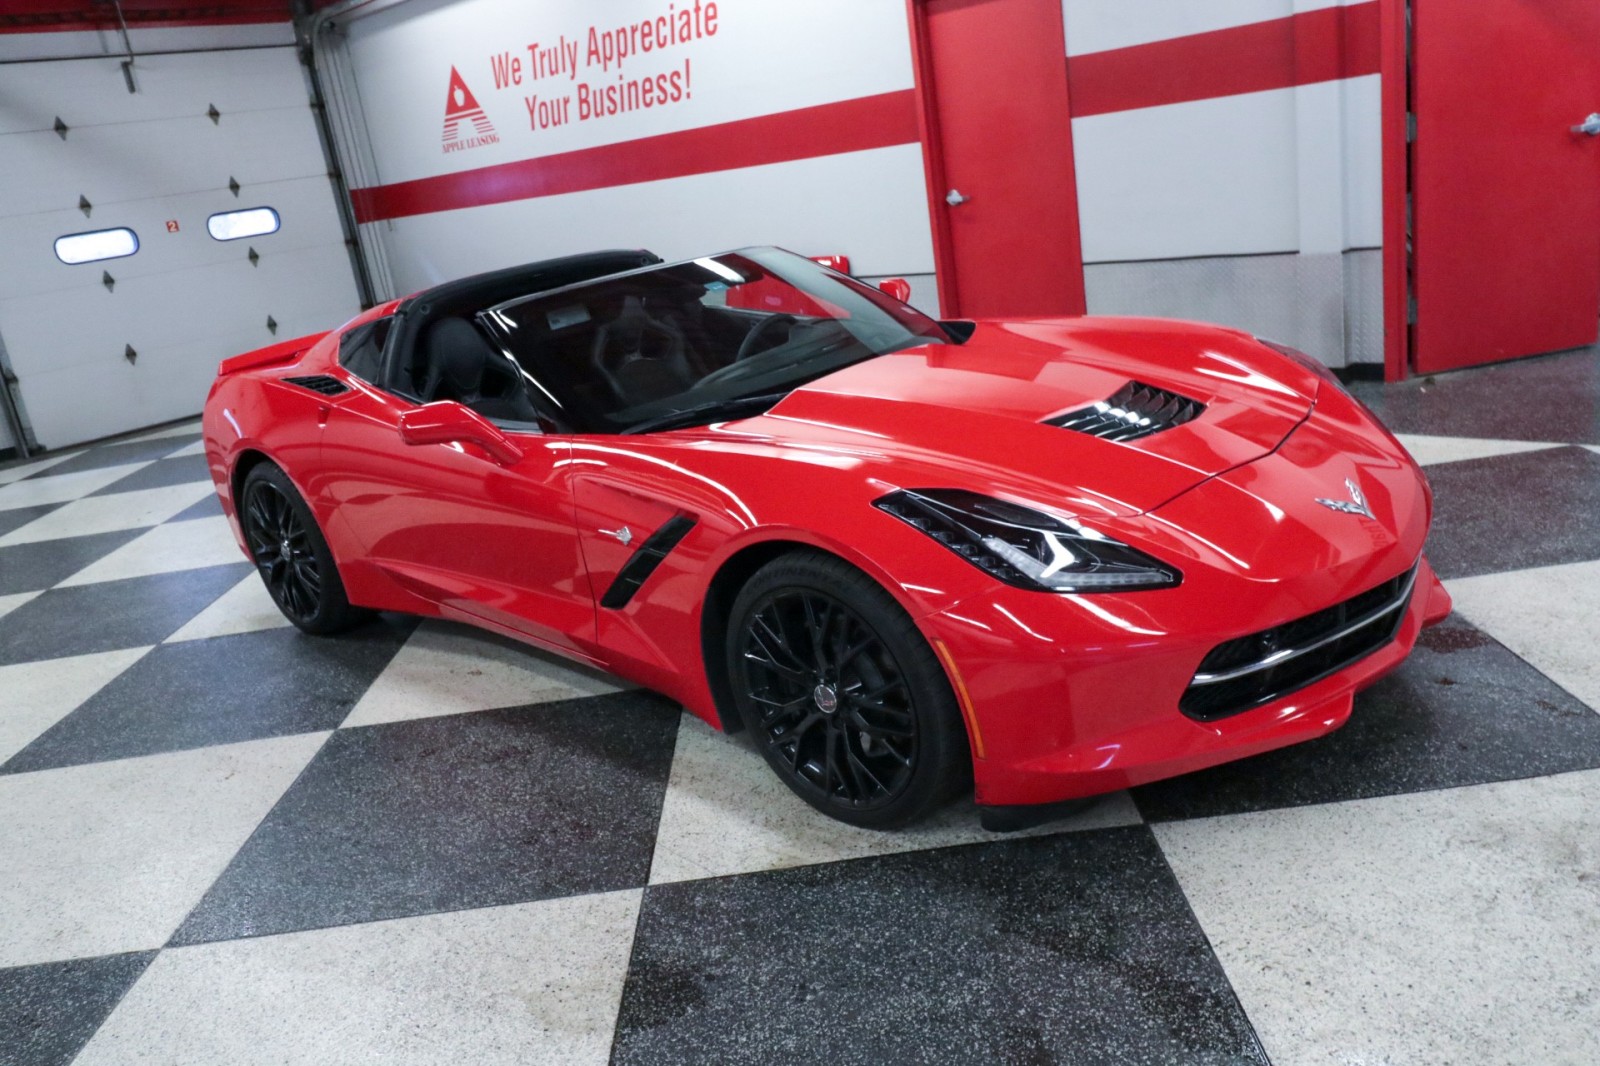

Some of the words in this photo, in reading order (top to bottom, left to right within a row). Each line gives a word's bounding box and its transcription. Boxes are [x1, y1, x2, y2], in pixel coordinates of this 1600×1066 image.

[490, 52, 522, 90] We
[527, 35, 578, 81] Truly
[586, 0, 718, 72] Appreciate
[524, 95, 570, 131] Your
[577, 58, 692, 122] Business!
[441, 140, 466, 153] APPLE
[466, 132, 500, 149] LEASING
[168, 221, 178, 232] 2
